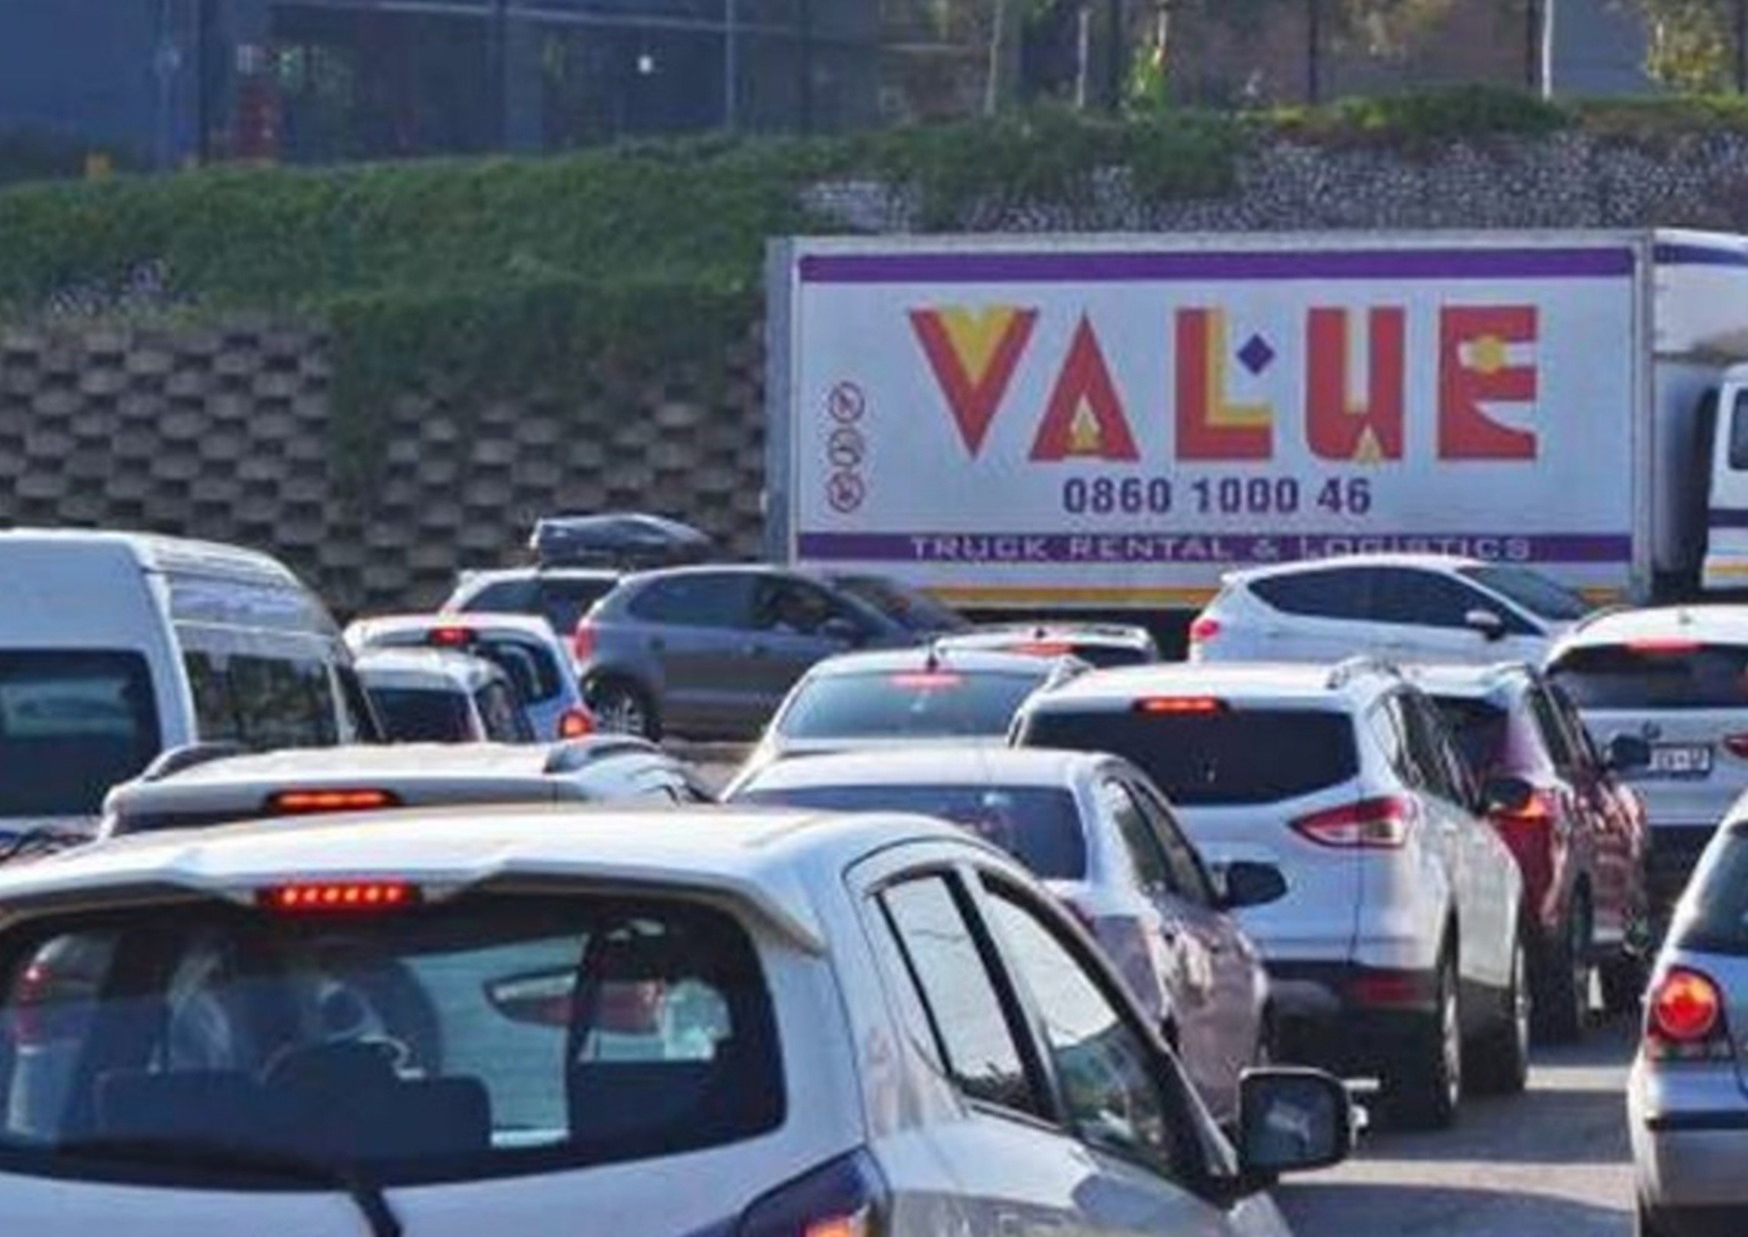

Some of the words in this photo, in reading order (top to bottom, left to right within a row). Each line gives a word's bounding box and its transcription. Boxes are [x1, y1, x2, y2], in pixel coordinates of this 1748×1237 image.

[909, 305, 1538, 462] VALUE
[1062, 477, 1172, 515] 0860
[1193, 477, 1299, 515] 1000
[1316, 477, 1372, 515] 46
[910, 537, 1048, 561] TRUCK
[1068, 537, 1232, 561] RENTAL
[1251, 538, 1280, 560] &
